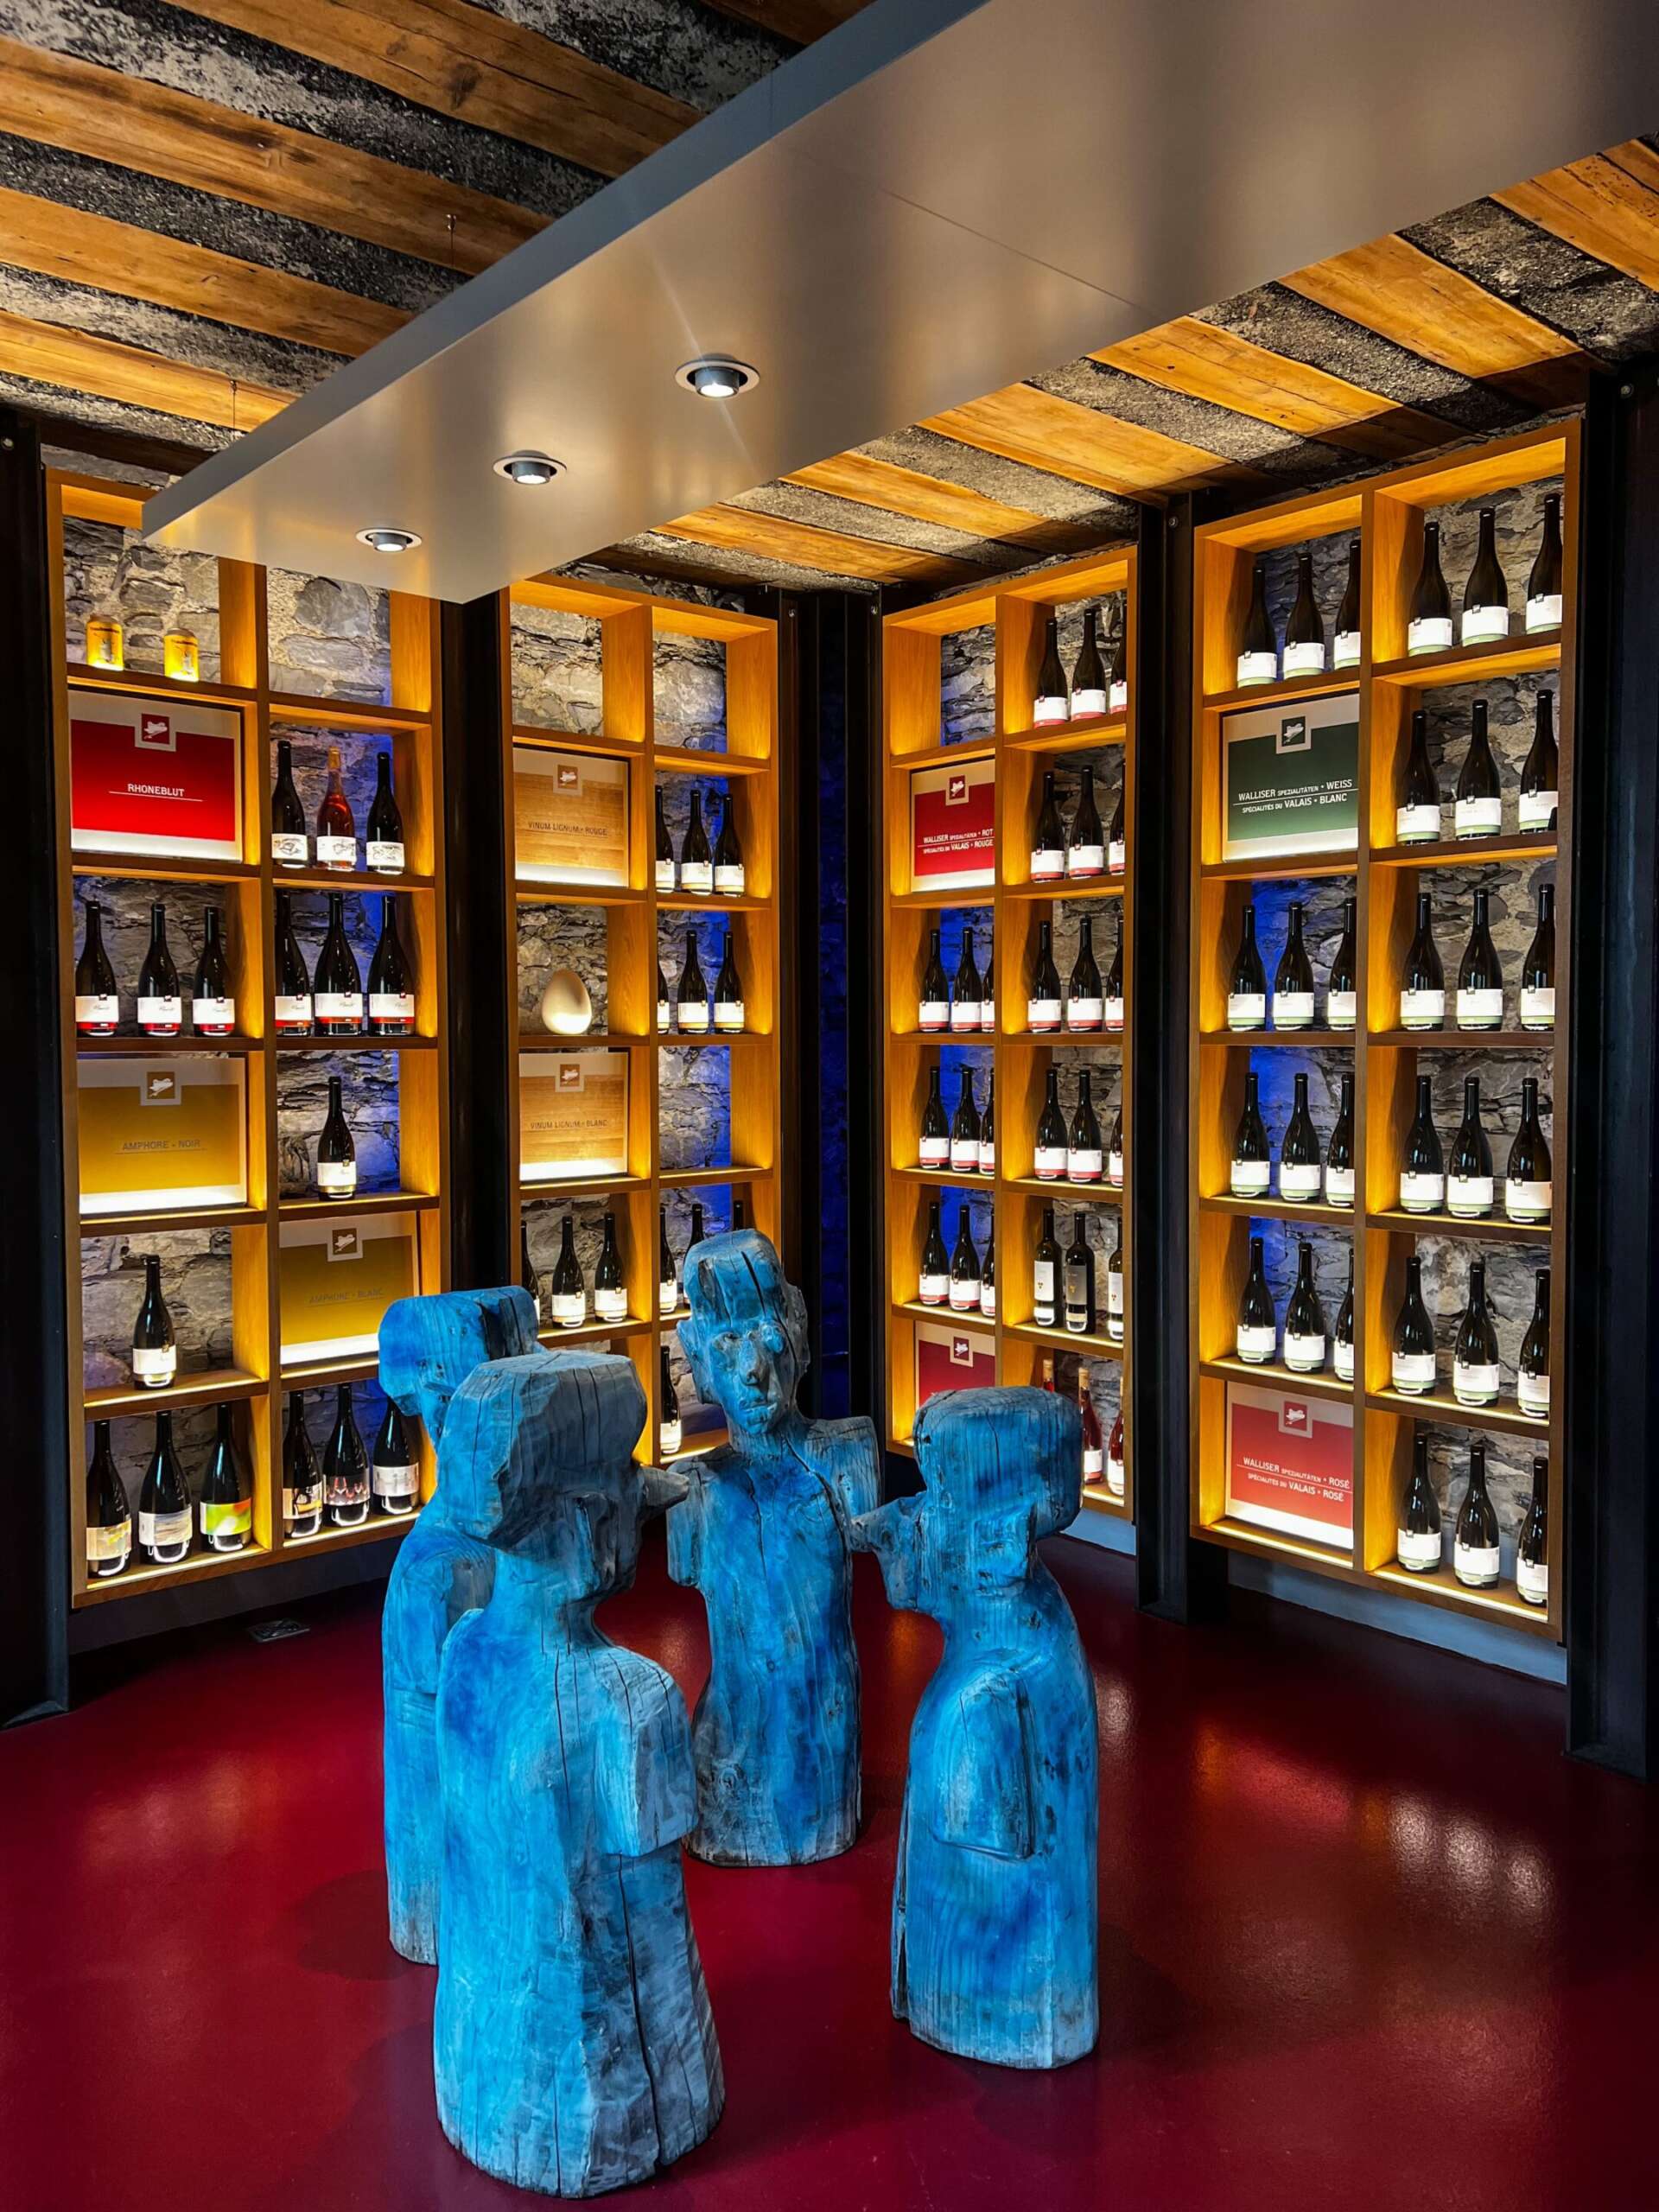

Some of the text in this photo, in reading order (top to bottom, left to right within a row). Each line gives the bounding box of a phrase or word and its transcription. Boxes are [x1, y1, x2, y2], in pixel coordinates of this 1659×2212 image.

[127, 783, 185, 797] RHONEBLUT
[1238, 779, 1353, 801] WALLISER SPEZIALITÄTEN WEISS
[1284, 797, 1313, 809] VALAIS
[1319, 793, 1348, 804] BLANC
[528, 821, 608, 836] VINUM LIGNUM ROUGE
[923, 834, 949, 844] WALLISER
[982, 828, 994, 836] ROT
[950, 842, 969, 851] VALAIS
[974, 839, 994, 849] ROUGE
[530, 1121, 553, 1129] VINUM
[122, 1139, 201, 1151] AMPHORE NOIR
[1243, 1457, 1280, 1473] WALLISER
[1328, 1476, 1351, 1489] ROSÉ
[1288, 1481, 1316, 1496] VALAIS
[1323, 1491, 1344, 1503] ROSÉ
